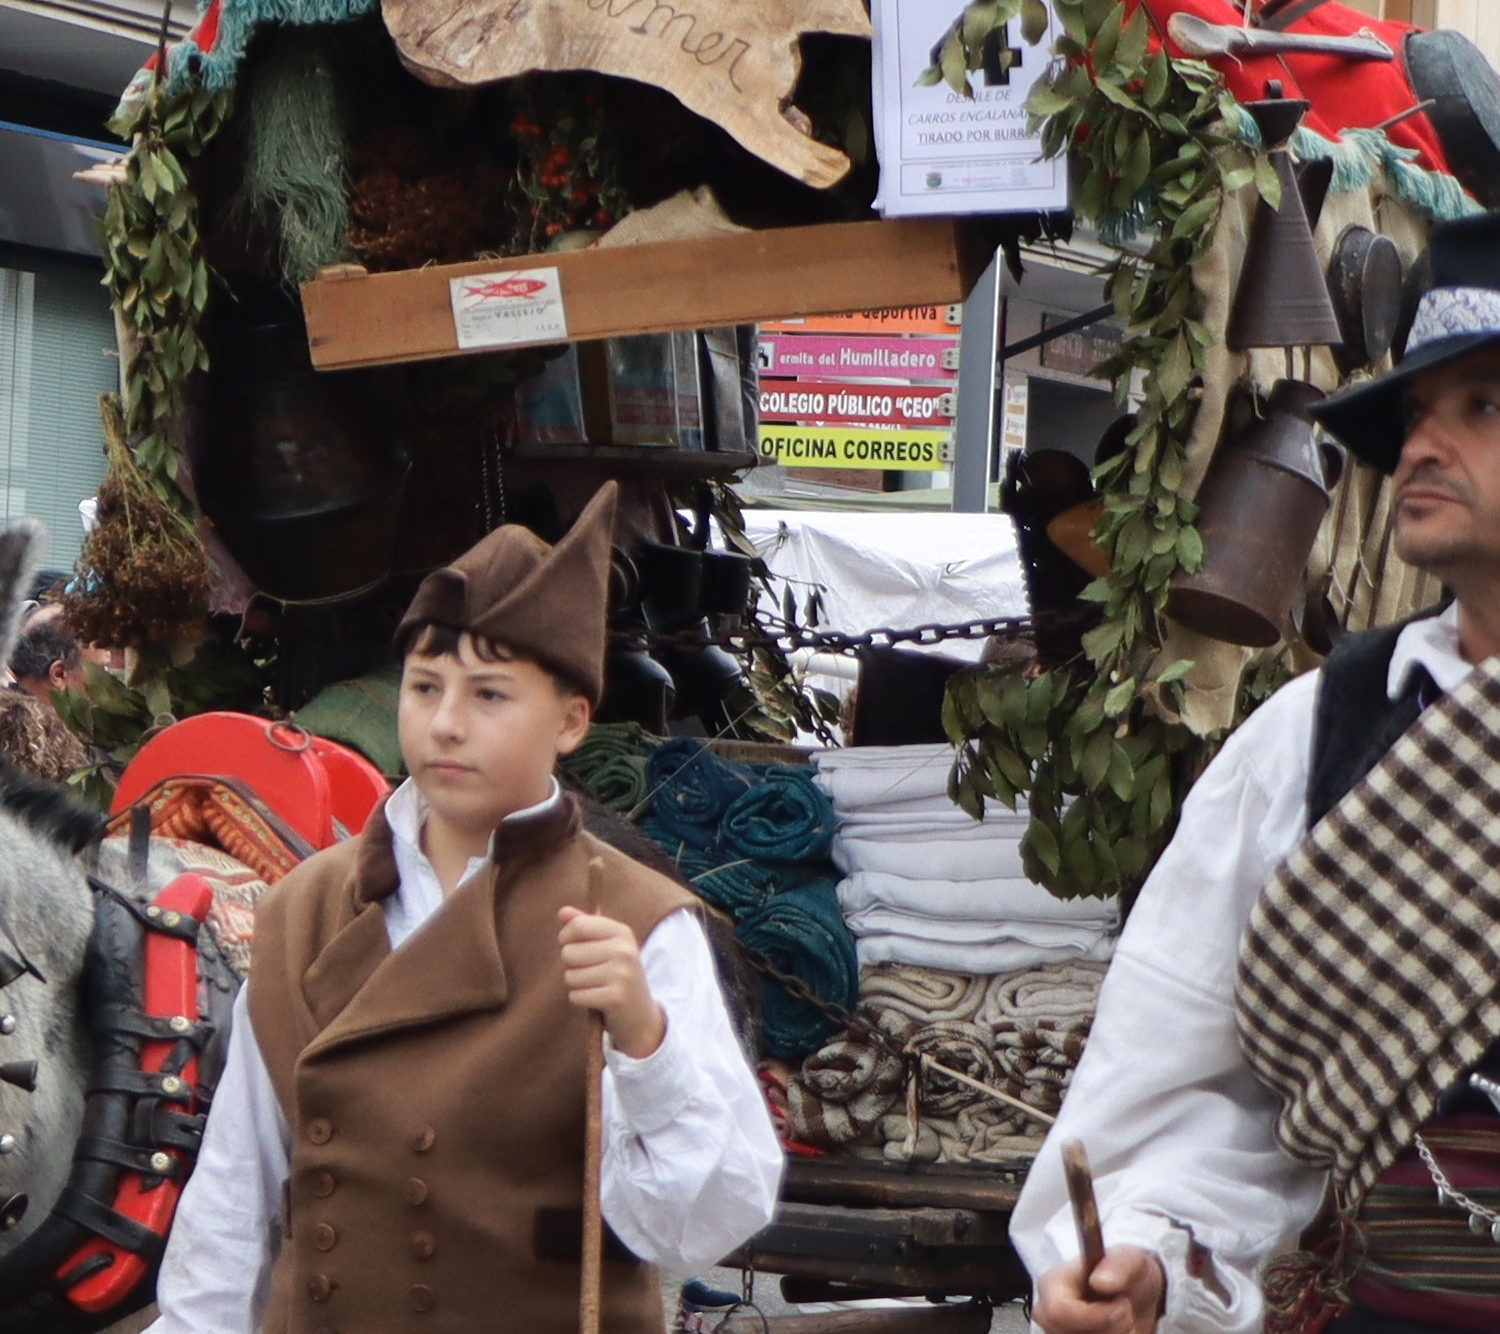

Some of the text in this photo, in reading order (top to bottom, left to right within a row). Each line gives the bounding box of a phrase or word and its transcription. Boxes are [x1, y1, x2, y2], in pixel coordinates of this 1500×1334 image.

[995, 89, 1012, 101] DE
[907, 108, 1029, 125] CARROS ENGALANA
[918, 131, 963, 144] TIRADO
[966, 130, 991, 142] POR
[495, 307, 544, 318] VALLEJO
[862, 306, 937, 323] deportiva
[779, 348, 936, 367] ermita del Humilladero
[759, 392, 824, 415] COLEGIO
[827, 389, 892, 417] PÚBLICO
[760, 437, 934, 462] OFICINA CORREOS
